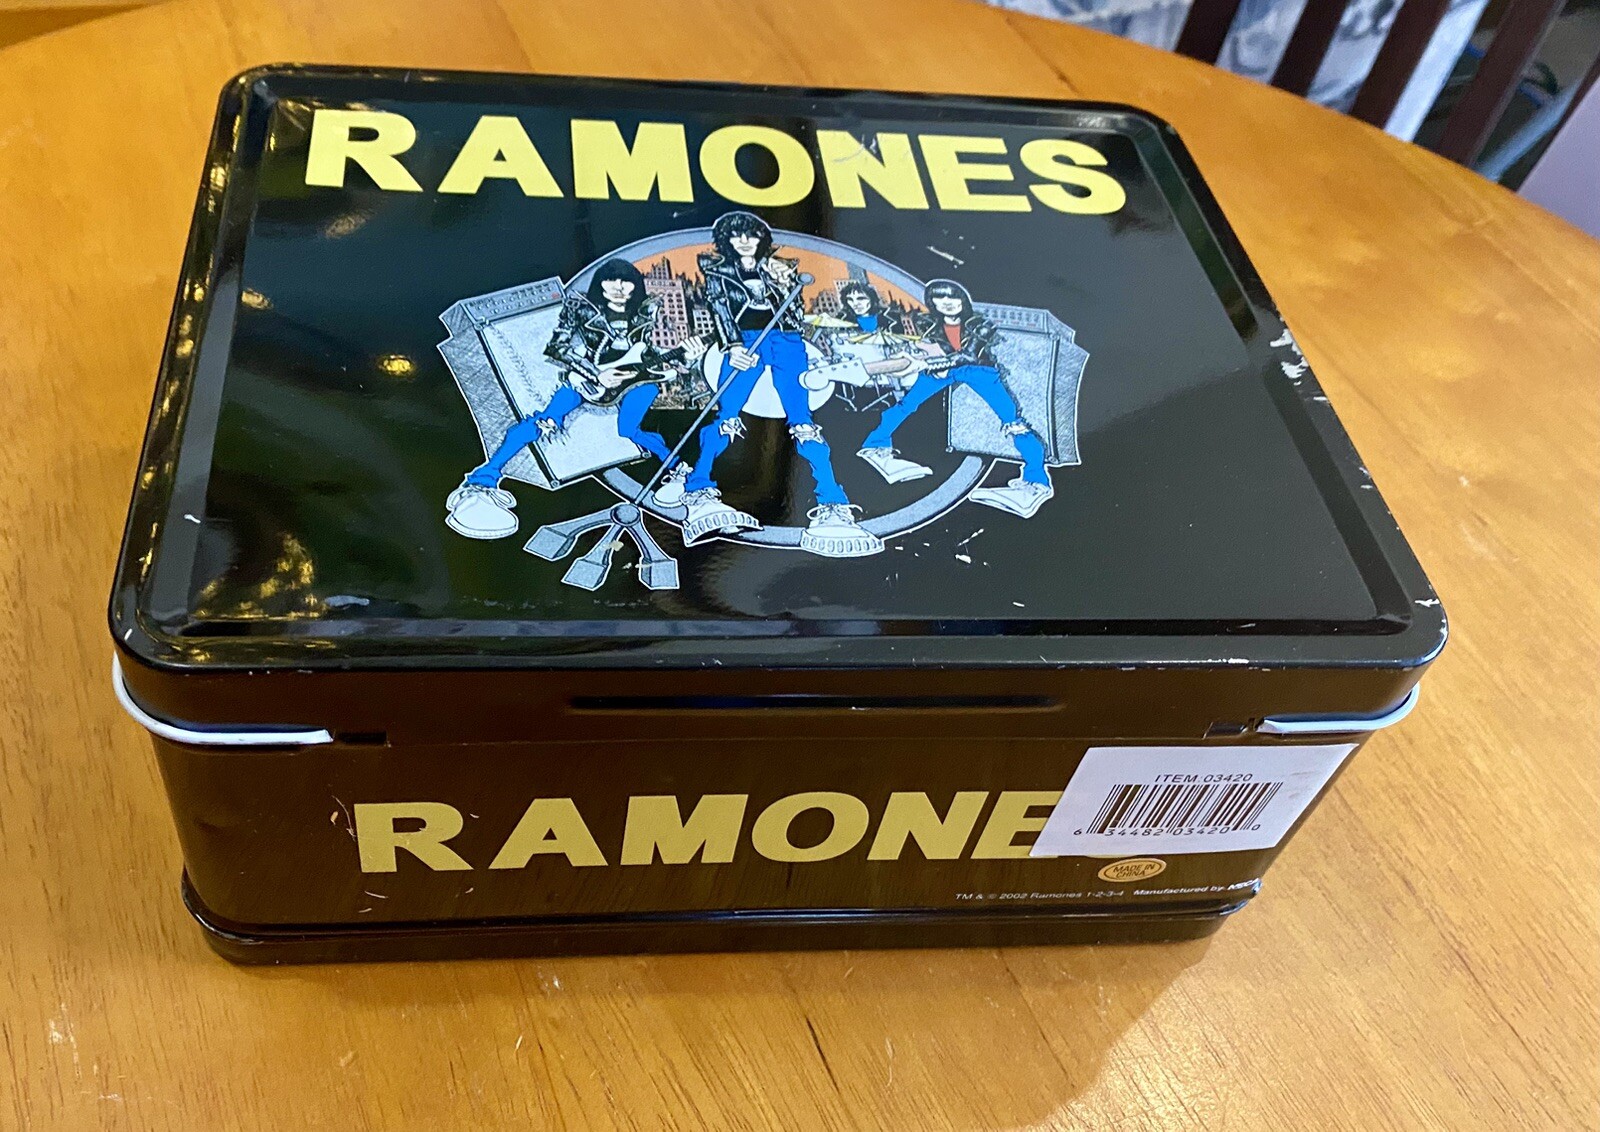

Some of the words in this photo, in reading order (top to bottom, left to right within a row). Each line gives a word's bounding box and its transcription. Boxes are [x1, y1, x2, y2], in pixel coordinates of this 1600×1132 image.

[305, 109, 1127, 215] RAMONES
[353, 791, 1136, 874] RAMONE
[1073, 828, 1083, 836] 6
[1104, 828, 1164, 837] 34482
[1172, 826, 1231, 836] 03420
[1251, 823, 1261, 831] 0
[1113, 864, 1142, 873] MADE
[1144, 862, 1155, 870] IN
[1116, 870, 1146, 878] CHINA
[1029, 891, 1083, 900] Ramones
[1133, 886, 1208, 895] Manufactured
